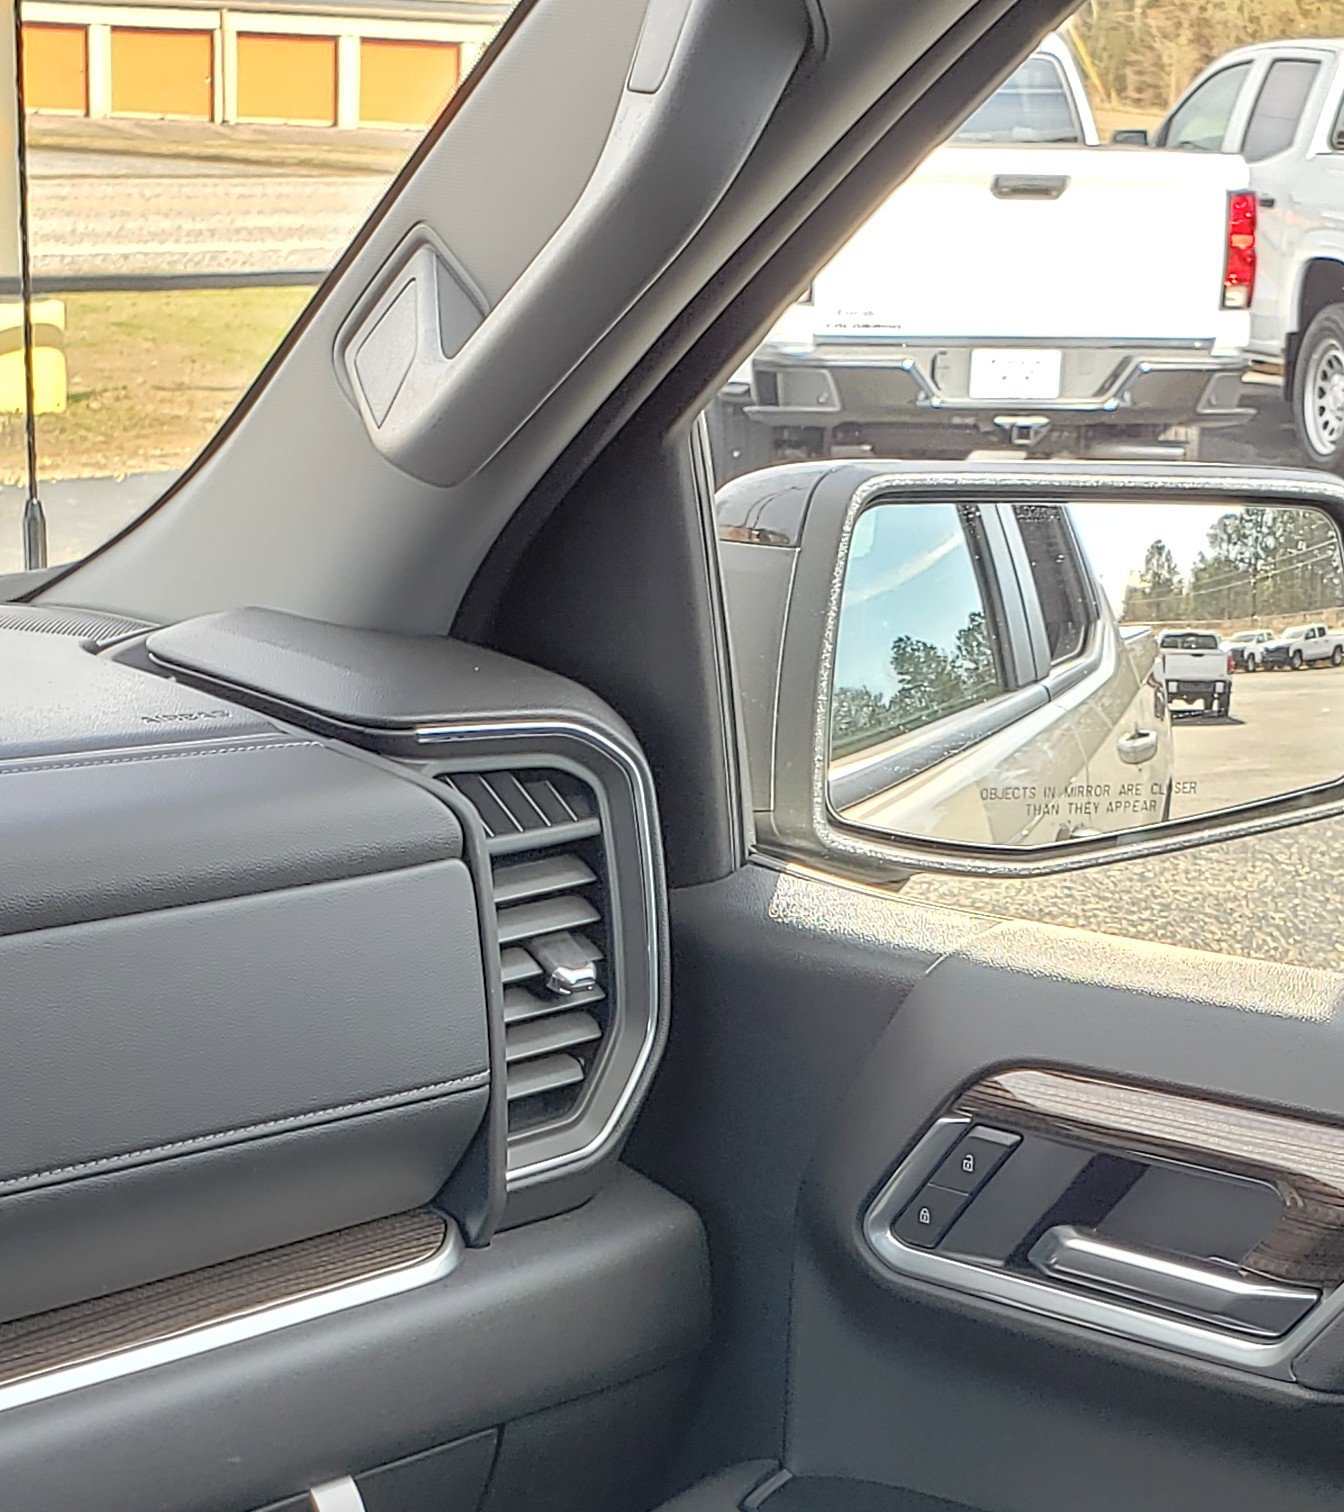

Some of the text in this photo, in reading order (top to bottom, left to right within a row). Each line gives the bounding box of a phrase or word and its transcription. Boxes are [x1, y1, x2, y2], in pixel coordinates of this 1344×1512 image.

[980, 782, 1197, 800] OBJECTS IN MIRROR ARE CLSER
[1026, 800, 1157, 816] THAN THEY APPEAR
